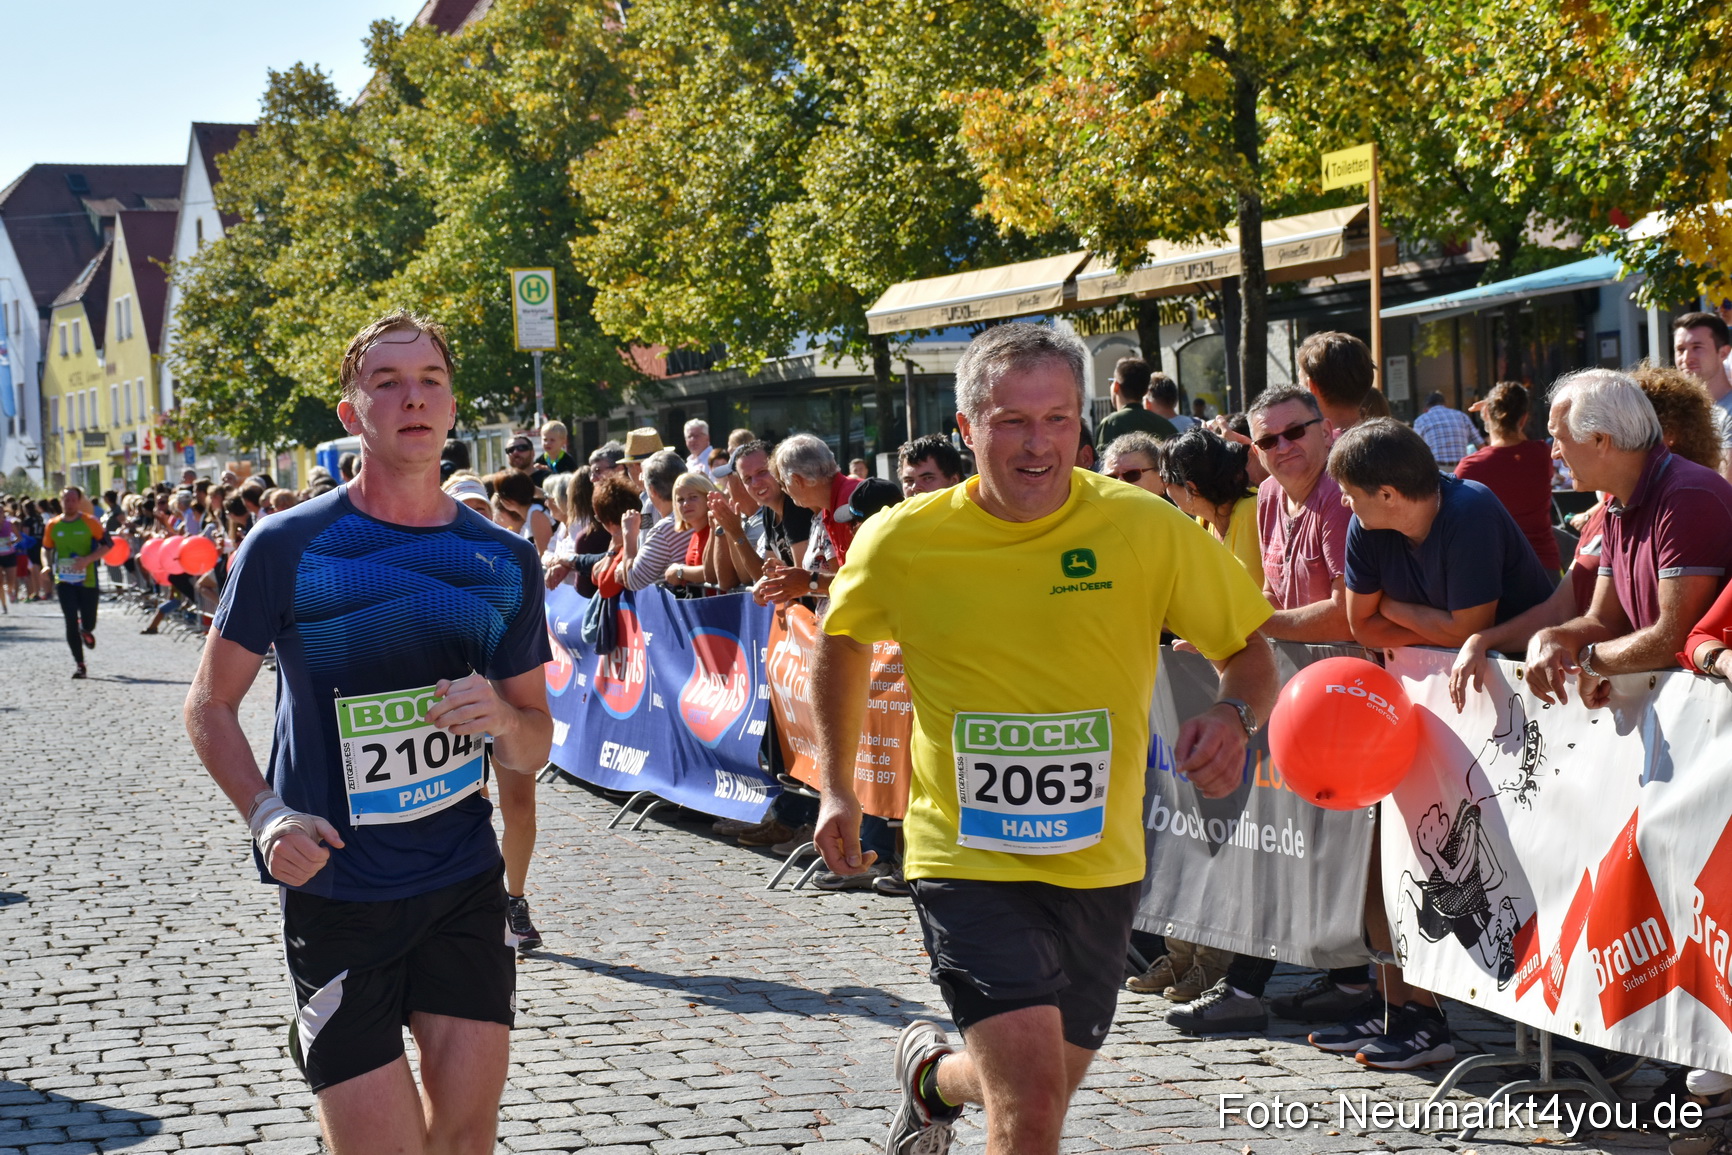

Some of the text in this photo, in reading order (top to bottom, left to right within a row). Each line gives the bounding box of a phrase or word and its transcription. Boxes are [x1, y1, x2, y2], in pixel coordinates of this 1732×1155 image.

[1331, 158, 1369, 177] Toiletten
[1049, 581, 1113, 595] JOHN DEERE
[1326, 678, 1399, 721] RÖDL
[868, 732, 880, 746] bei
[883, 736, 900, 749] uns:
[967, 718, 1099, 750] BOCK
[362, 731, 472, 784] 2104
[877, 769, 896, 785] 897
[974, 763, 1093, 806] 2063
[398, 779, 451, 808] PAUL
[1002, 819, 1068, 838] HANS
[1147, 795, 1305, 859] bockonline.de
[1688, 884, 1732, 989] Bra
[1588, 917, 1668, 995] Braun
[1622, 972, 1648, 993] Sicher
[1648, 966, 1660, 979] ist
